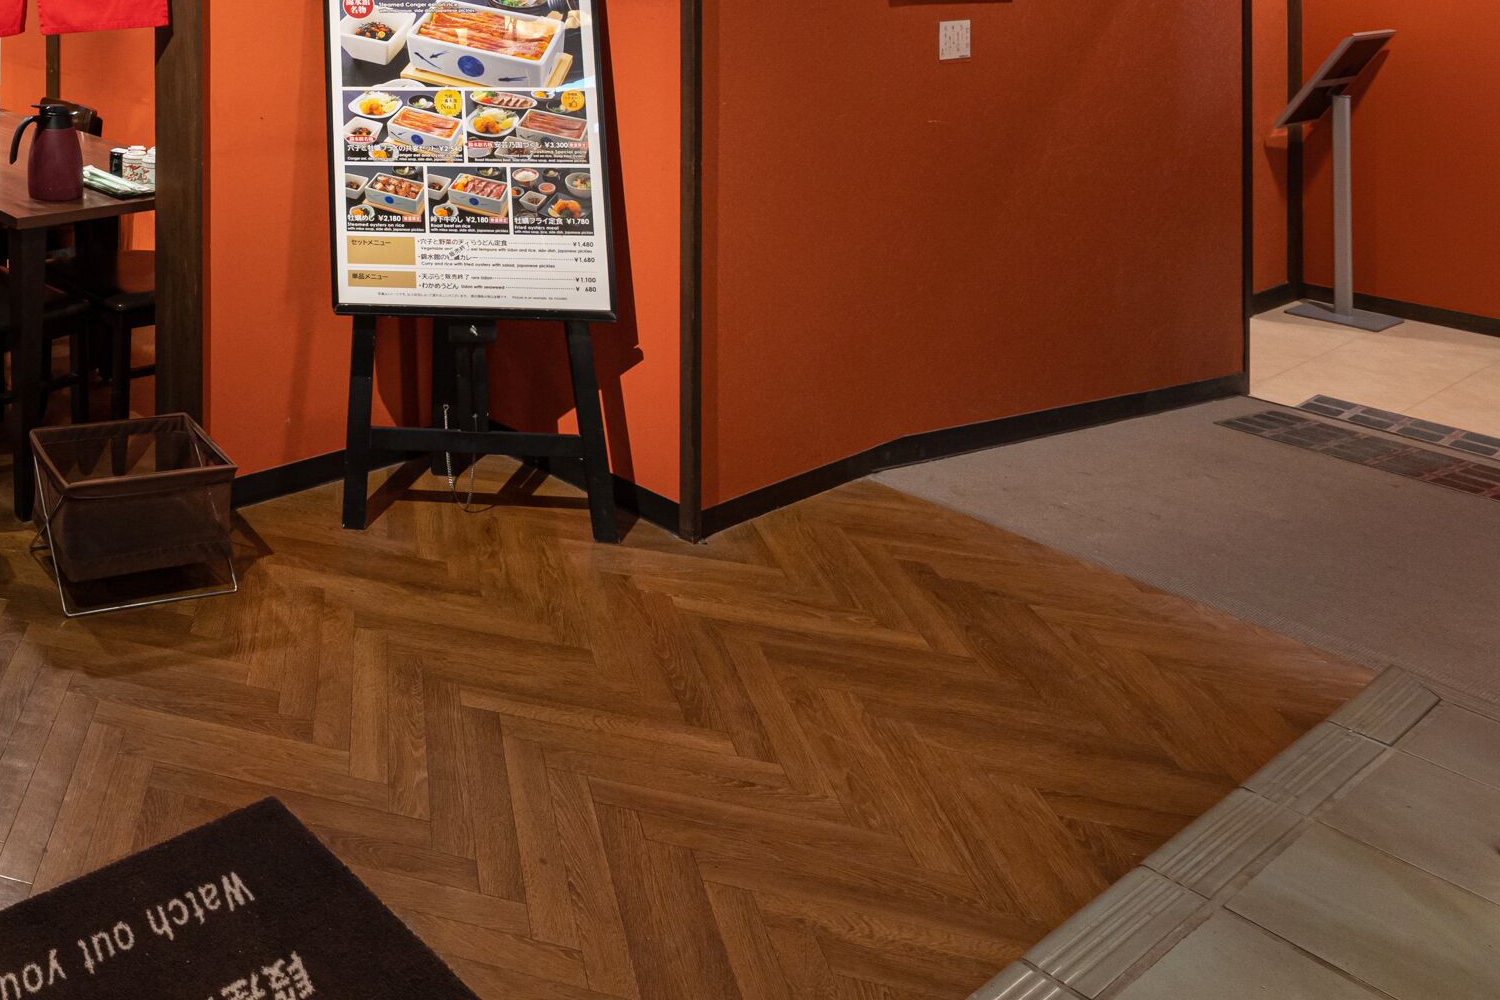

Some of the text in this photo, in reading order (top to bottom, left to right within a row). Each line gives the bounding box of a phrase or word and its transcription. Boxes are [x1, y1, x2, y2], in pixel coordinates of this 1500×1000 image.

[351, 5, 367, 14] 名物
[351, 273, 388, 281] 単品メニュー
[146, 871, 255, 941] Watch
[77, 920, 136, 976] out
